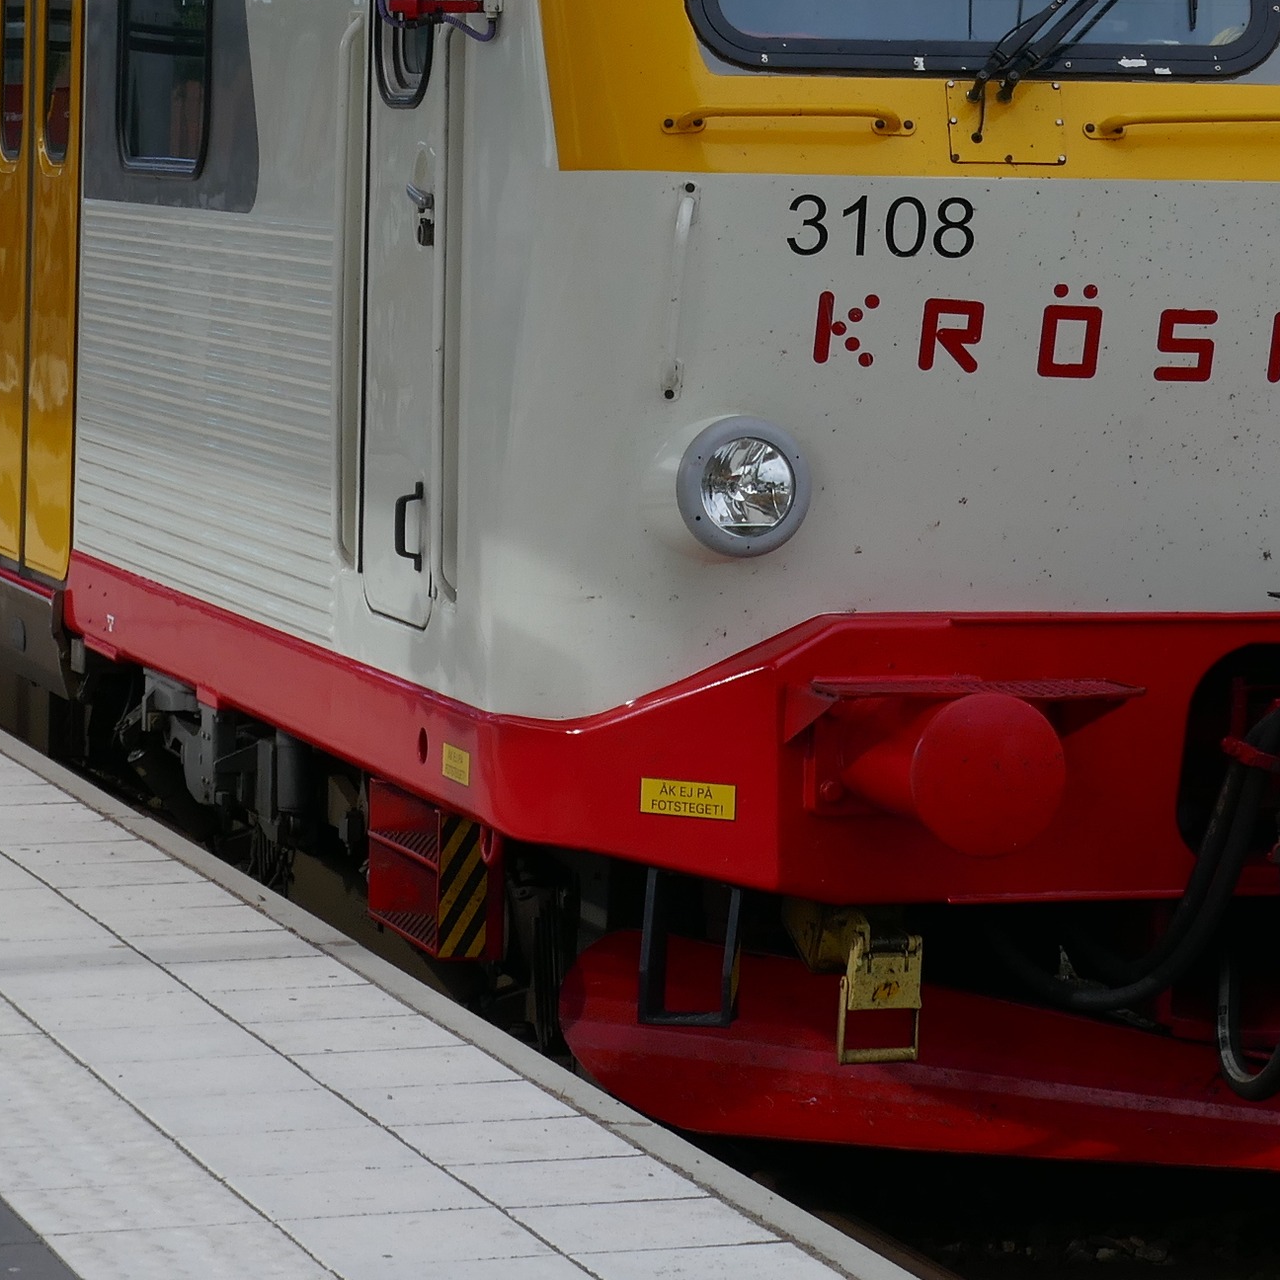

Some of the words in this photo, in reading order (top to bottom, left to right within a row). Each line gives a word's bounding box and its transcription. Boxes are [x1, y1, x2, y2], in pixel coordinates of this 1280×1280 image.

[786, 194, 976, 258] 3108
[660, 782, 676, 797] ÅK
[680, 786, 693, 798] EJ
[697, 786, 713, 800] PÅ
[651, 799, 724, 816] FOTSTEGET!
